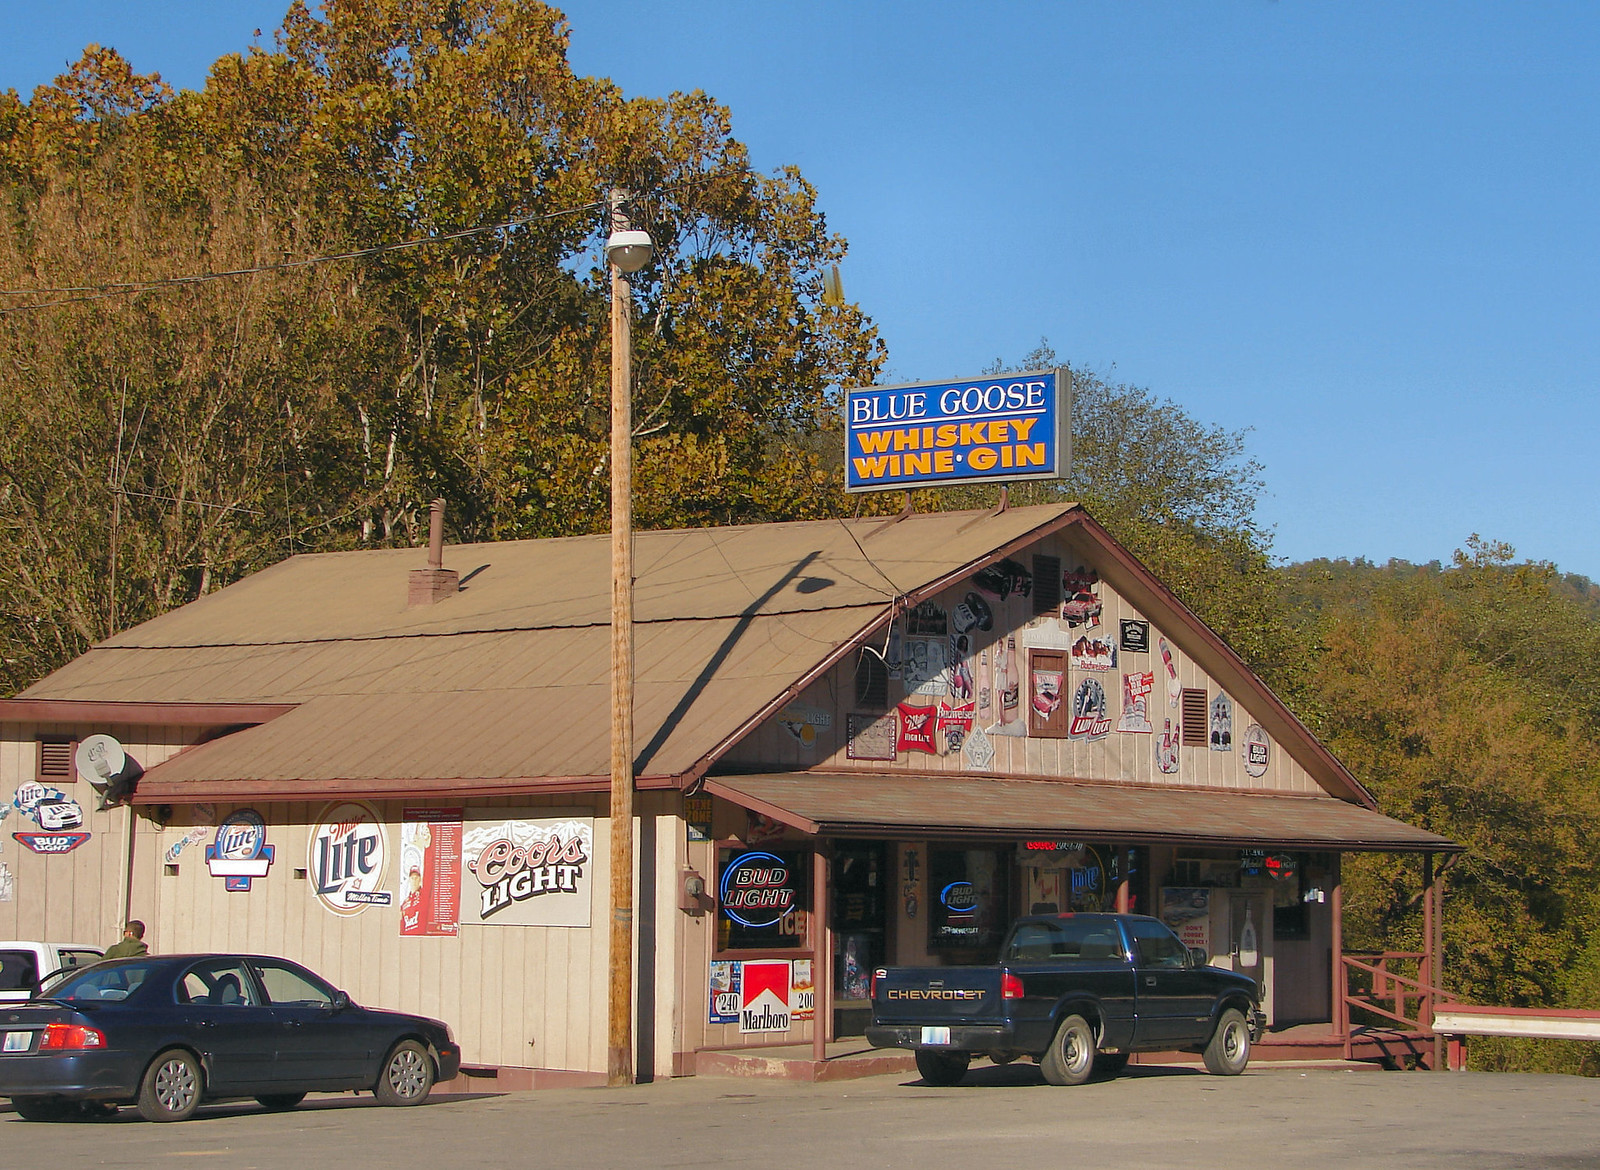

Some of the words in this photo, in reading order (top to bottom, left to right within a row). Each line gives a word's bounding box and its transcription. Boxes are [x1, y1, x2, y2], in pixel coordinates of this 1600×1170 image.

[852, 392, 927, 423] BLUE
[940, 381, 1046, 415] GOOSE
[856, 417, 1039, 454] WHISKEY
[807, 712, 831, 725] LIGHT
[904, 713, 929, 732] Miller
[937, 706, 975, 719] Budweiser
[904, 733, 918, 741] HIGH
[1250, 753, 1266, 763] LIGHT
[1252, 745, 1265, 754] BUD
[329, 814, 366, 842] Miller
[33, 837, 68, 845] BUD
[223, 830, 256, 855] Lite
[316, 830, 378, 895] Lite
[468, 835, 587, 886] Coors
[735, 868, 789, 888] BUD
[480, 864, 580, 919] LIGHT
[723, 889, 796, 909] LIGHT
[946, 895, 976, 905] LIGHT
[952, 887, 973, 896] BUD
[778, 912, 807, 935] ICE
[888, 989, 986, 1001] CHEVROLET
[742, 1004, 788, 1030] Marlboro
